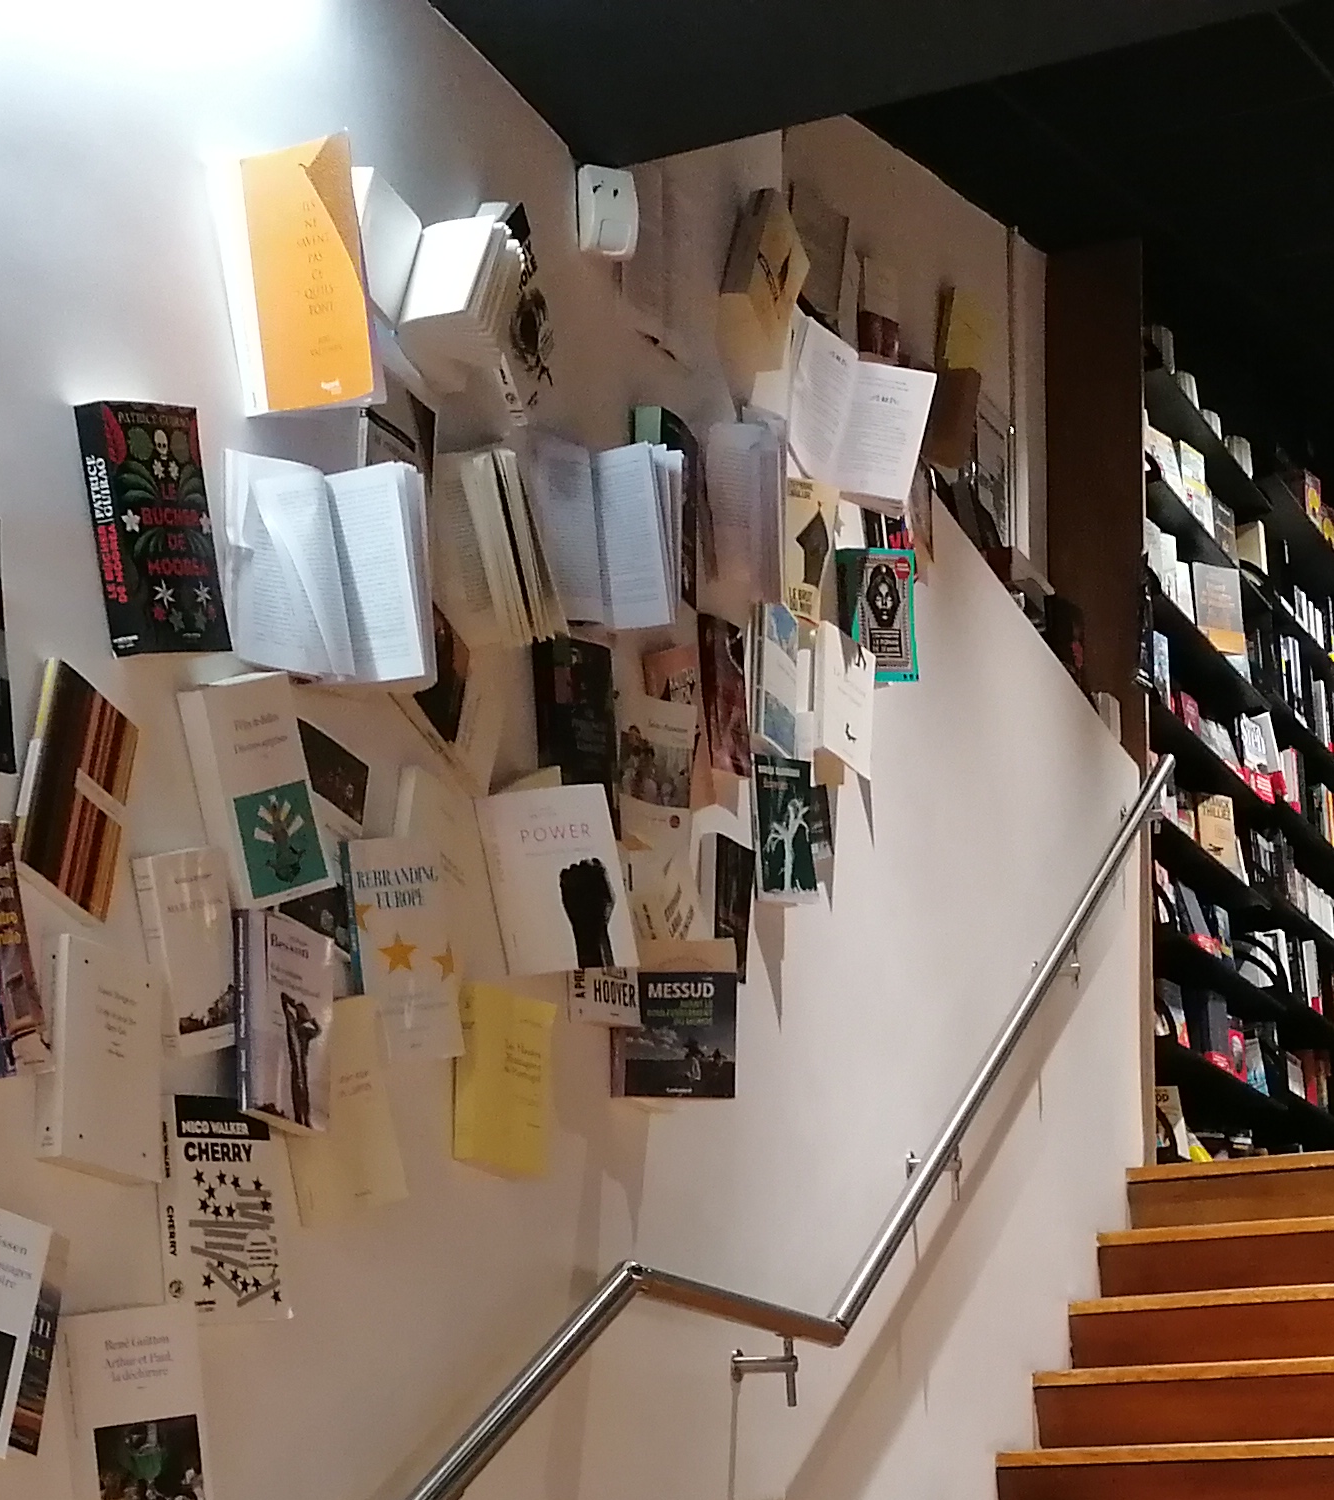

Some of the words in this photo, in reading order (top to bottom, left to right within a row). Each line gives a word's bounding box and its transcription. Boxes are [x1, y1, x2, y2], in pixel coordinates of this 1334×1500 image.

[520, 822, 592, 843] POWER
[355, 865, 439, 890] REBRANDING
[375, 887, 425, 911] EUROPE
[593, 979, 637, 1009] HOOVER
[647, 981, 716, 999] MESSUD
[210, 1121, 250, 1136] WALKER
[183, 1141, 253, 1163] CHERRY
[166, 1205, 178, 1257] CHERRY
